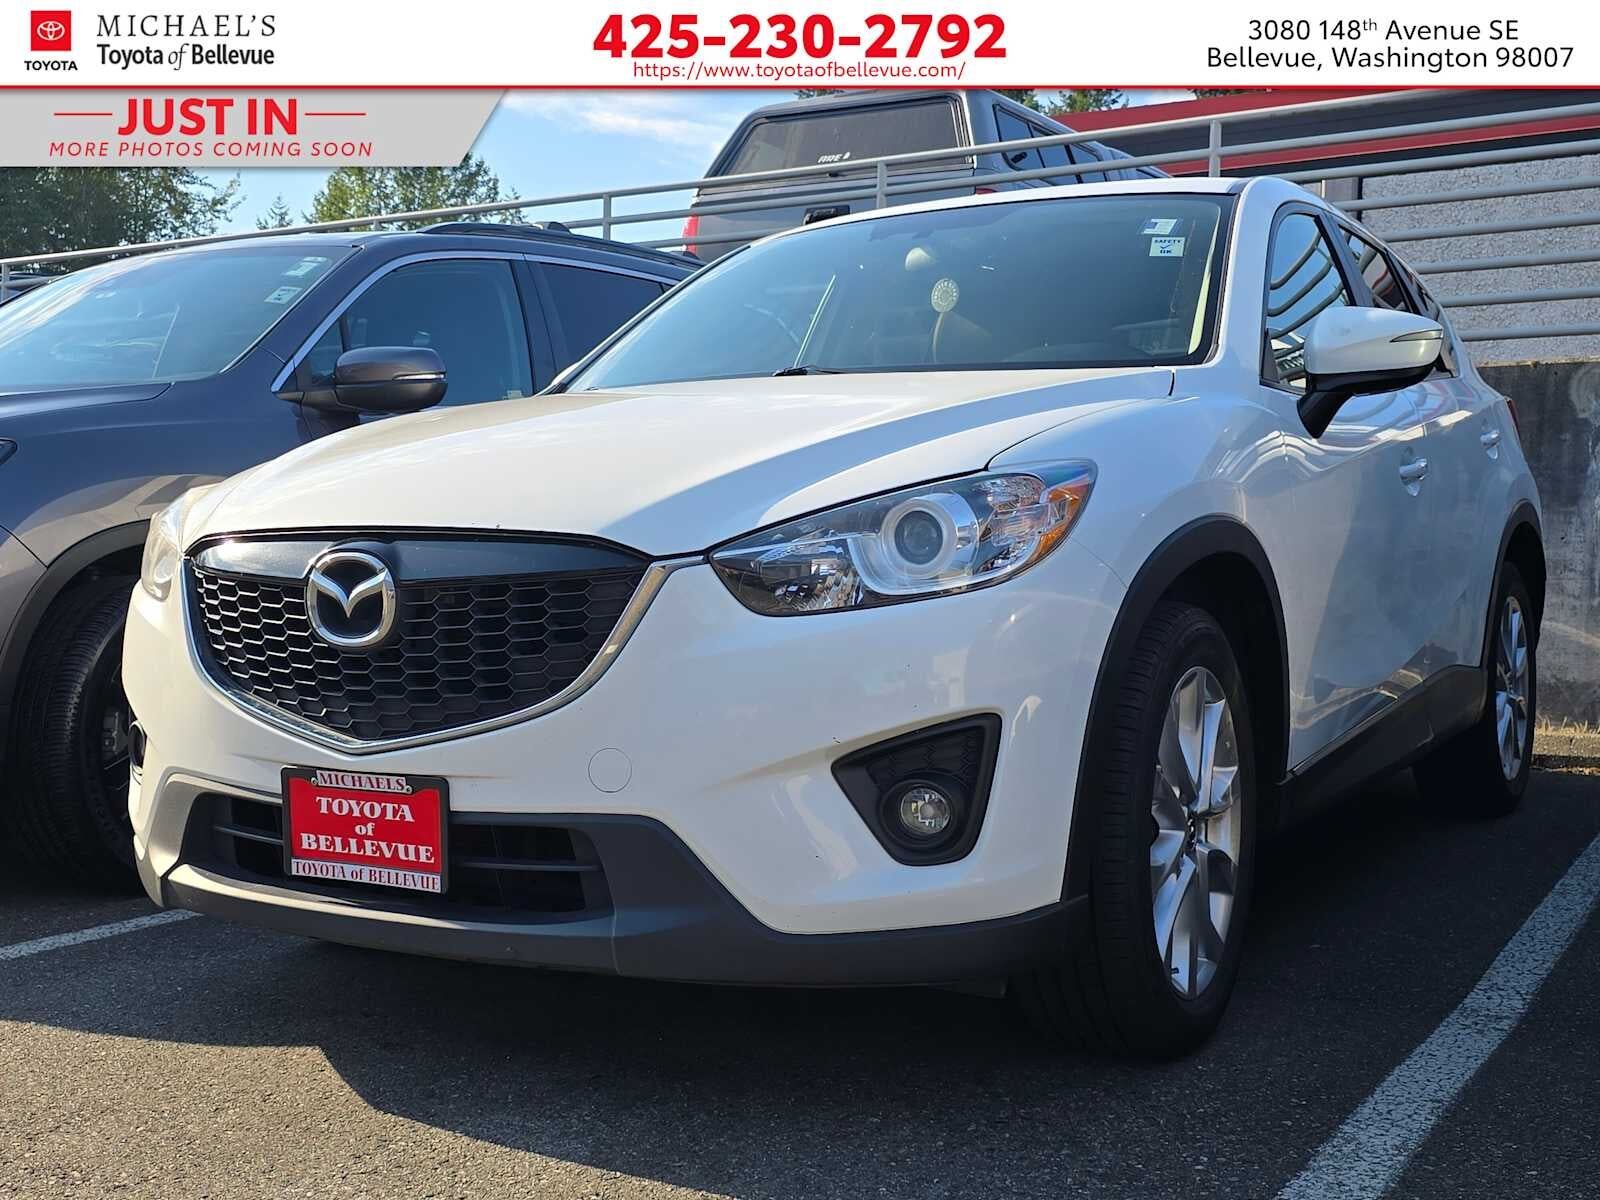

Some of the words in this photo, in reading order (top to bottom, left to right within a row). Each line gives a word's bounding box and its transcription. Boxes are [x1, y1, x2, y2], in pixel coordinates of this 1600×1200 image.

[319, 772, 406, 792] MICHAELS
[316, 796, 415, 823] TOYOTA
[355, 823, 376, 837] of
[300, 833, 436, 864] BELLEVUE
[293, 860, 347, 880] TOYOTA
[350, 867, 365, 881] of
[368, 869, 441, 891] BELLEVUE
